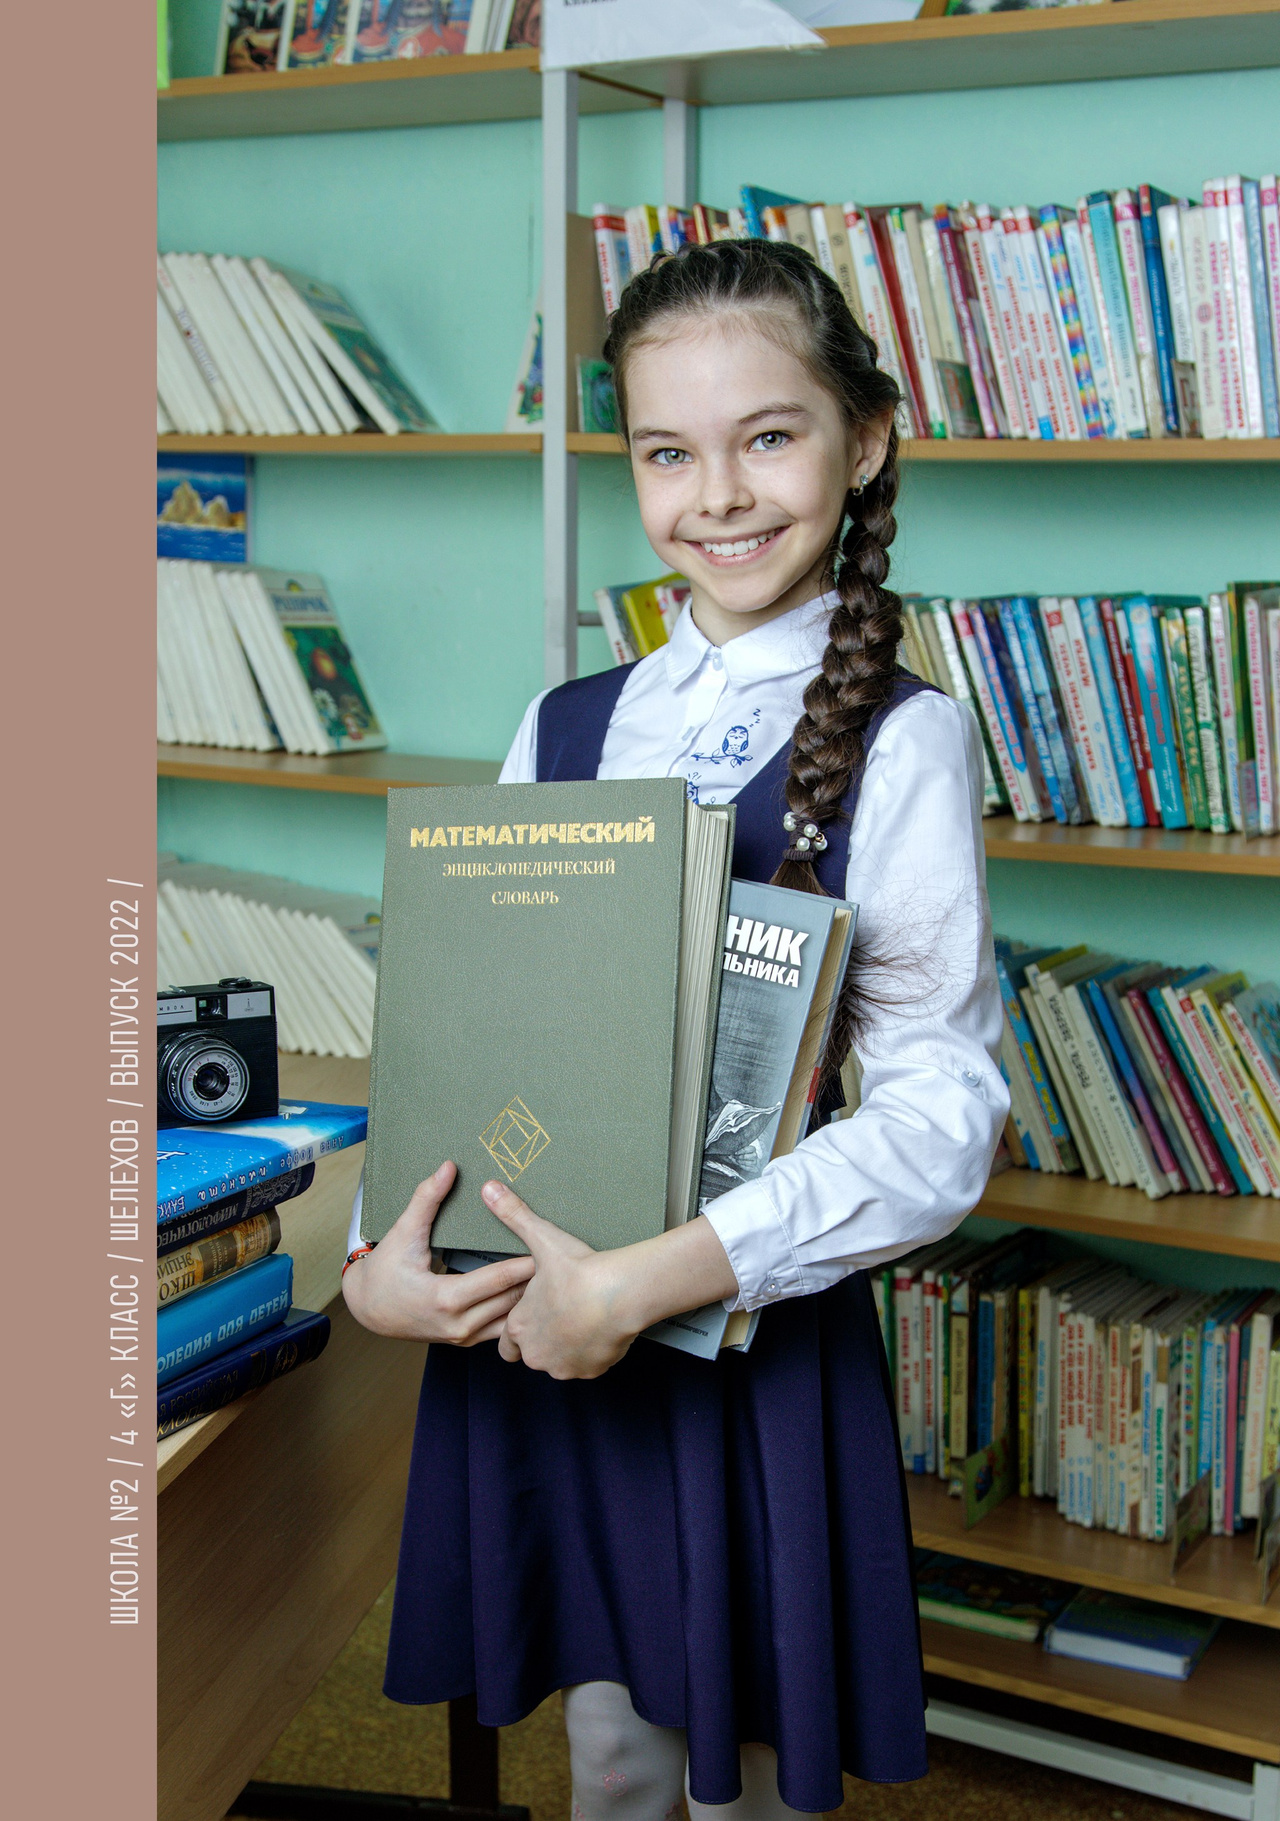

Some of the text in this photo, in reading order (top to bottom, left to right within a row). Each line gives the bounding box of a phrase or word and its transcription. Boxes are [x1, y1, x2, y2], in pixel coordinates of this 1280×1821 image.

[1073, 636, 1093, 687] МАУГЛИ
[1176, 664, 1199, 766] МАУГЛИ
[410, 815, 655, 848] МАТЕМАТИЧЕСКИЙ
[442, 857, 616, 879] ЭНЦИКЛОПЕДИЧЕСКИЙ
[491, 889, 559, 906] СЛОВАРЬ
[725, 914, 810, 967] НИК
[1046, 992, 1093, 1090] РЕБЯТА ЗВЕРЯТА
[1085, 1036, 1115, 1094] СКАЗКИ
[197, 1166, 267, 1199] планета
[279, 1147, 314, 1168] Иоффе
[217, 1314, 244, 1341] ДЛЯ
[248, 1289, 289, 1325] ДЕТЕЙ
